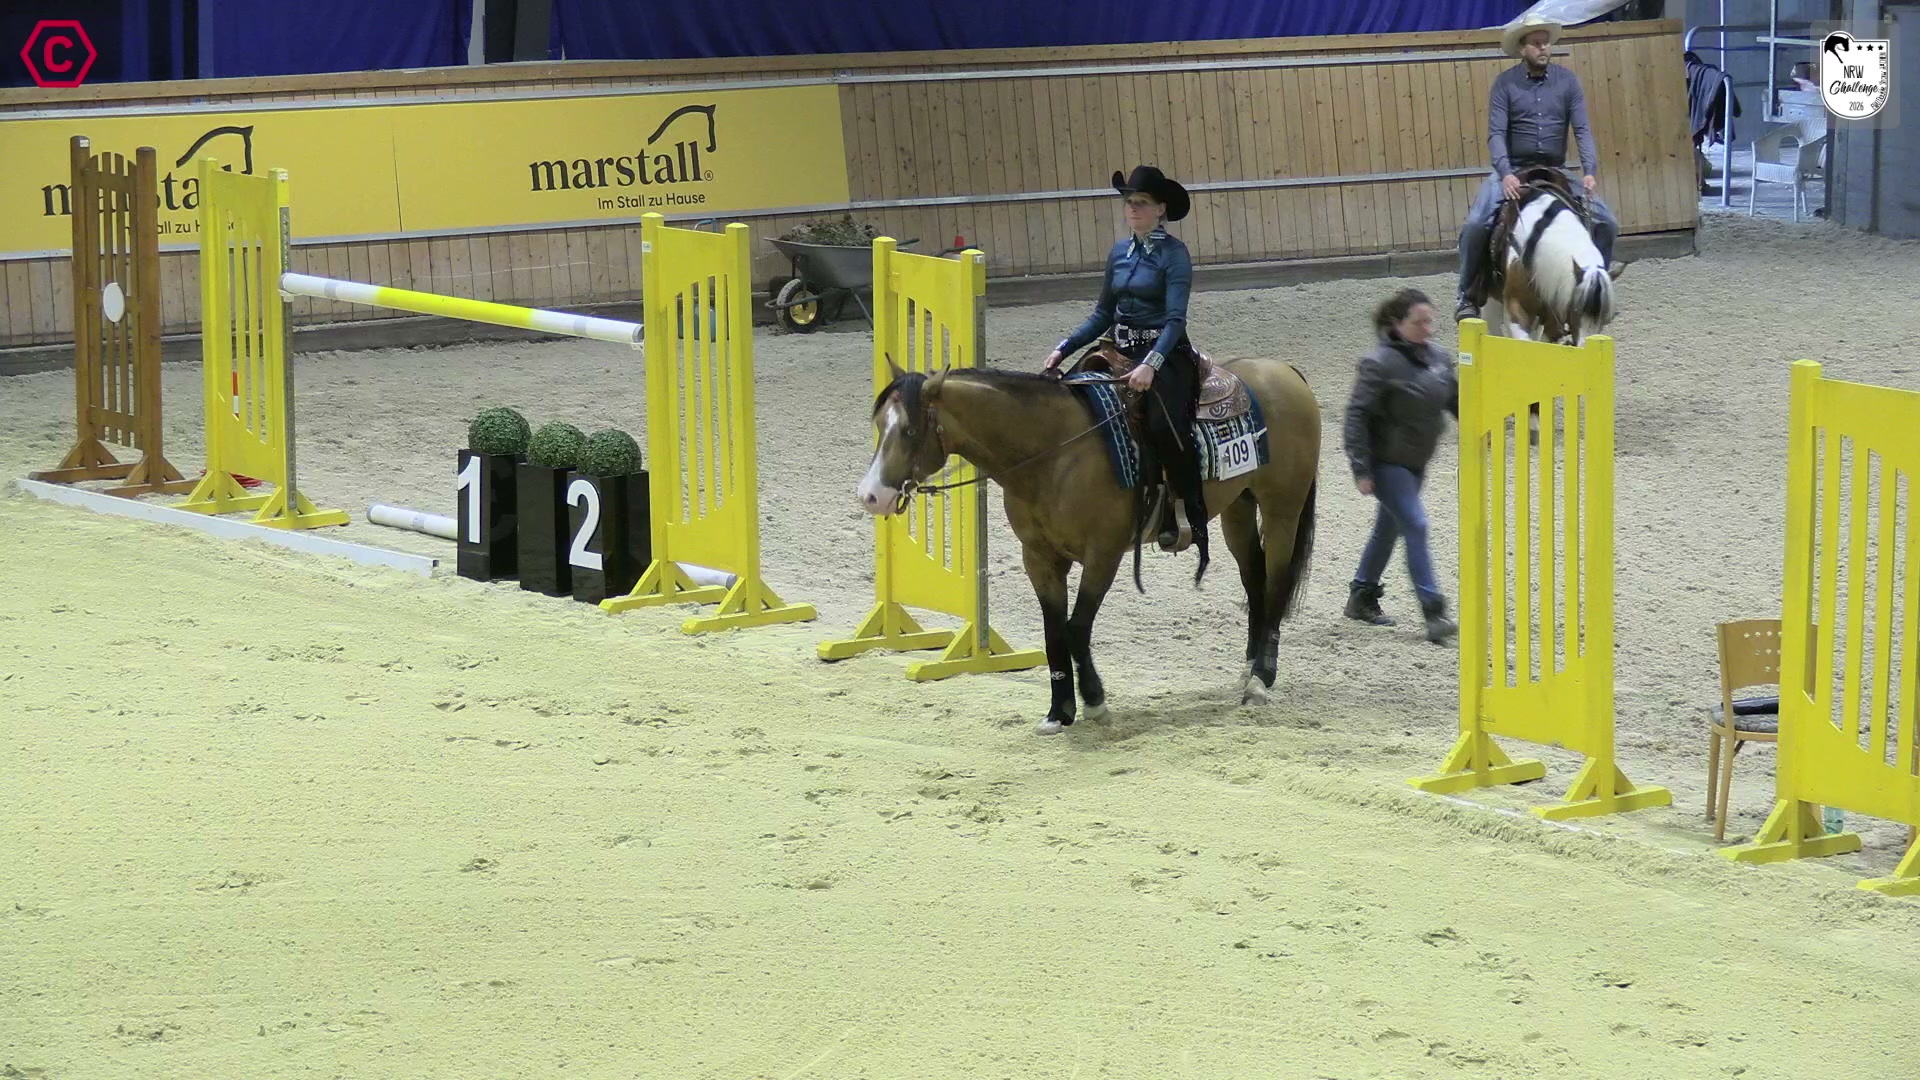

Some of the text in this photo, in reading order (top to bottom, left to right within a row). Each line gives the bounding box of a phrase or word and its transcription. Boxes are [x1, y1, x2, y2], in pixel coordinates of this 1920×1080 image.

[598, 192, 706, 210] Im Stall zu Hause
[175, 223, 192, 234] zu
[1225, 439, 1249, 468] 109
[457, 455, 481, 544] 1
[566, 479, 603, 571] 2
